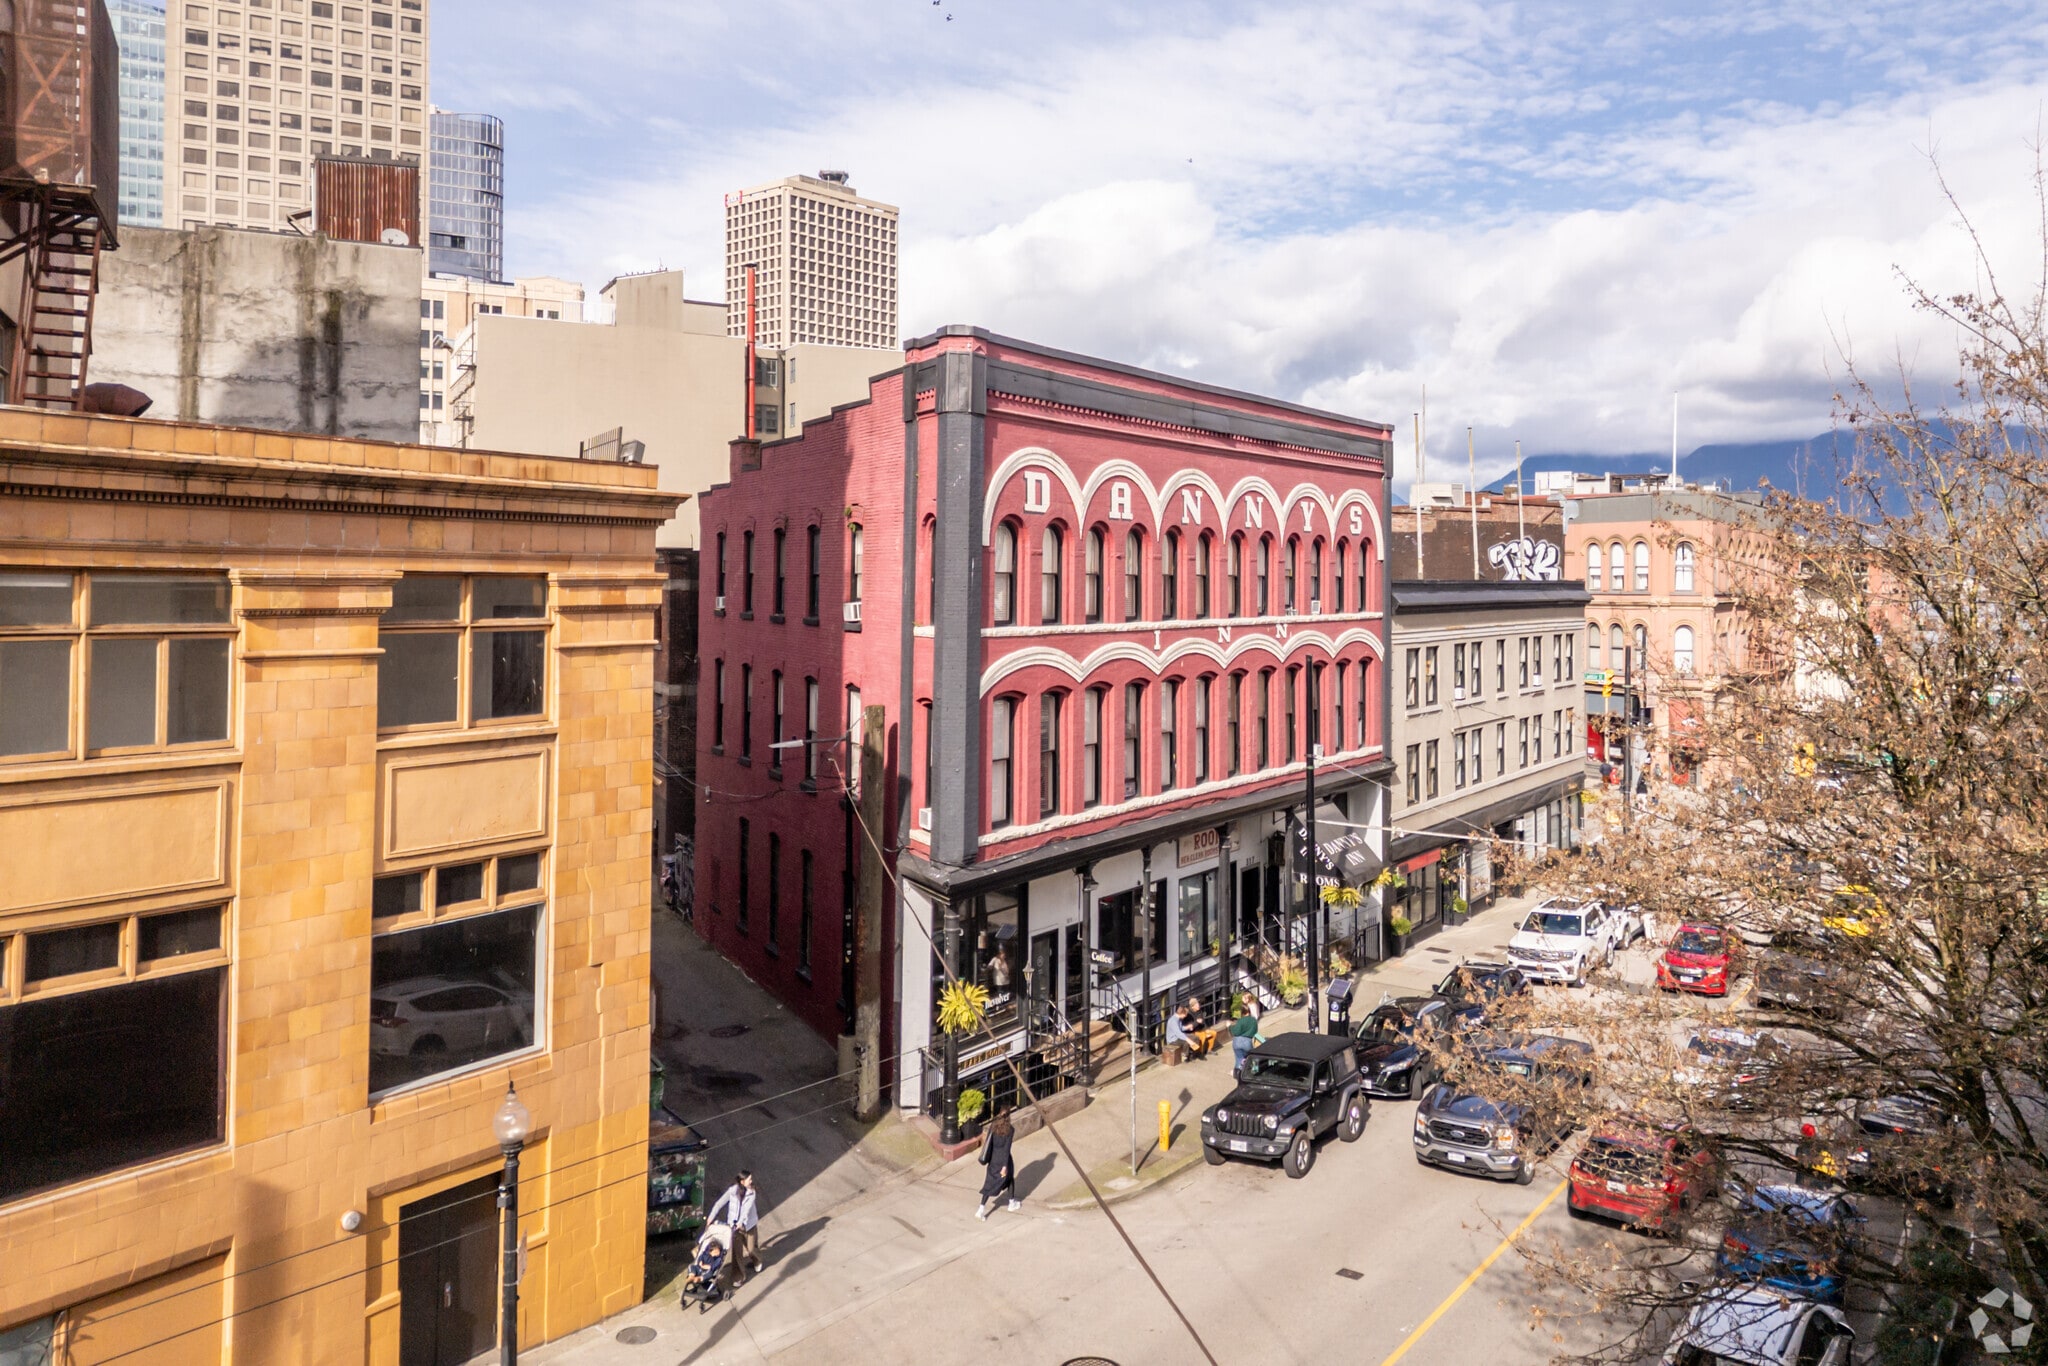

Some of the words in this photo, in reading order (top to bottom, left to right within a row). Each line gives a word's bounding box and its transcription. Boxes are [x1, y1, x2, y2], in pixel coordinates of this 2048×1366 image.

[1023, 470, 1363, 535] DANNY'S
[1153, 623, 1288, 651] INN
[1298, 828, 1335, 871] DNY'S
[1300, 873, 1340, 887] ROMS
[1091, 951, 1113, 964] Coffee
